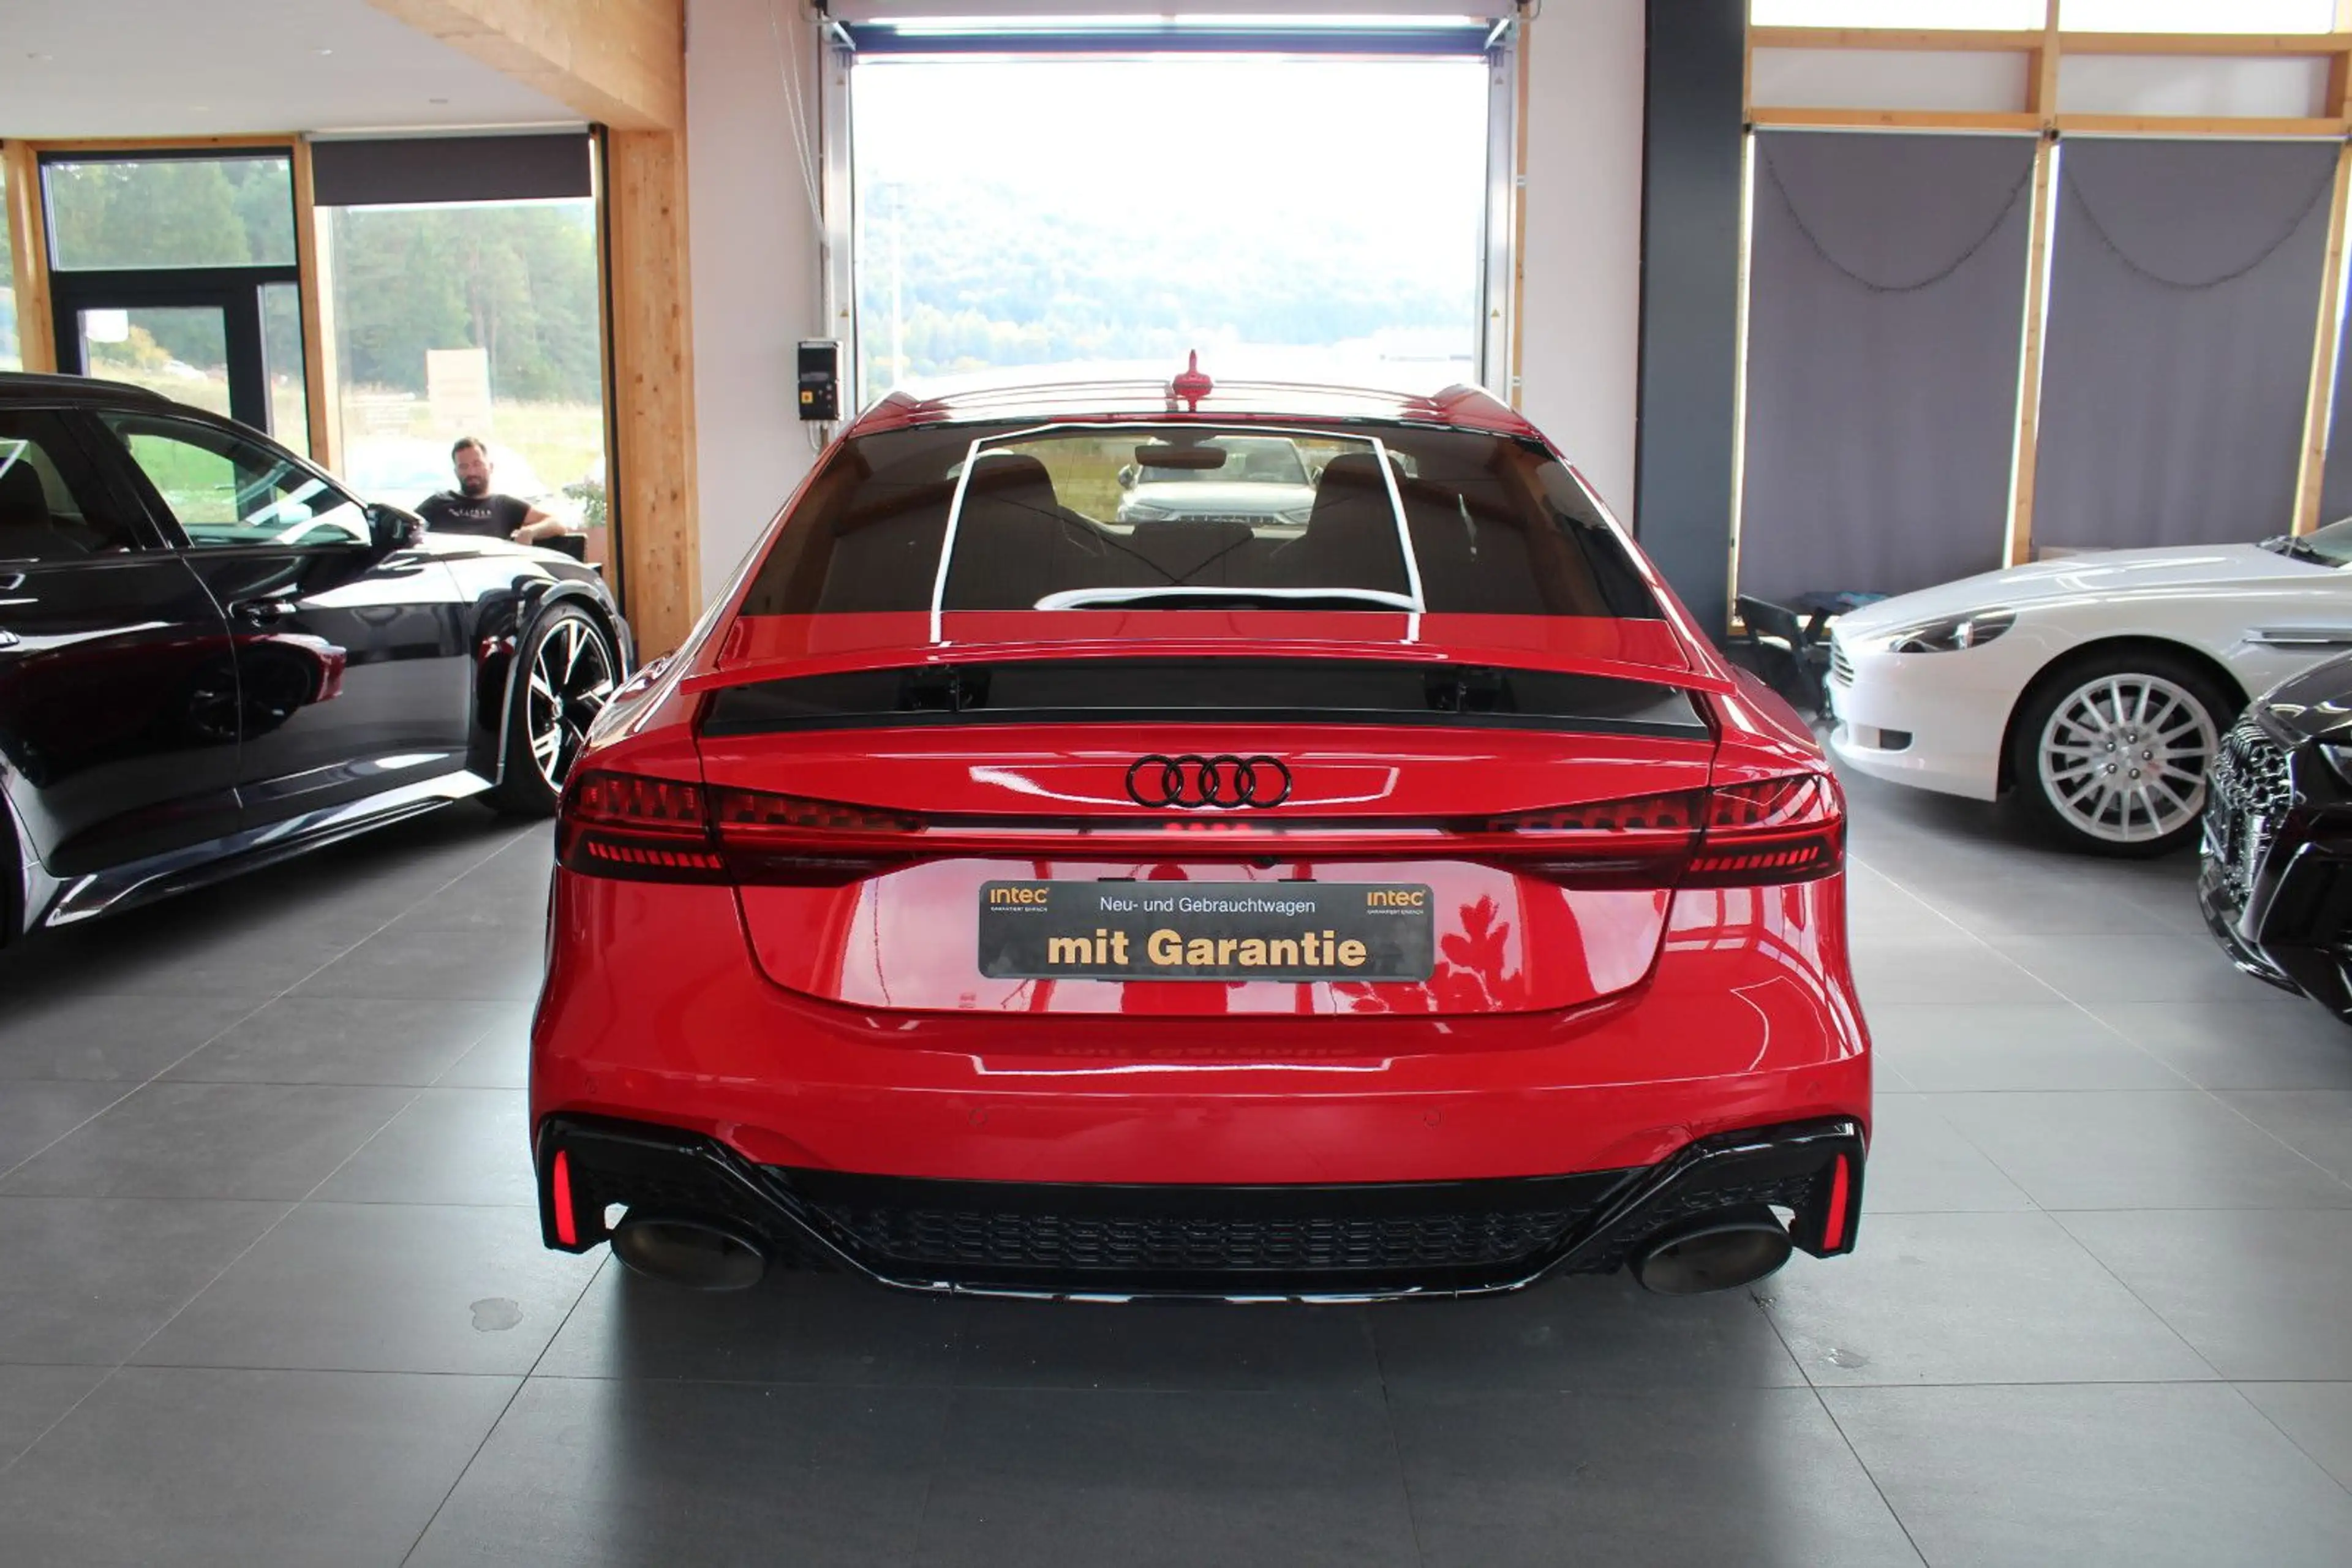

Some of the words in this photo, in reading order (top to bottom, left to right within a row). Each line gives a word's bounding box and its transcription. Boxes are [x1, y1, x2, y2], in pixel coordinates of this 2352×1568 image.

[990, 887, 1047, 903] intec
[1366, 890, 1424, 906] intec
[1100, 897, 1139, 912] Neu-
[1144, 897, 1174, 913] und
[1178, 897, 1316, 916] Gebrauchtwagen
[1048, 929, 1129, 964] mit
[1147, 929, 1366, 967] Garantie
